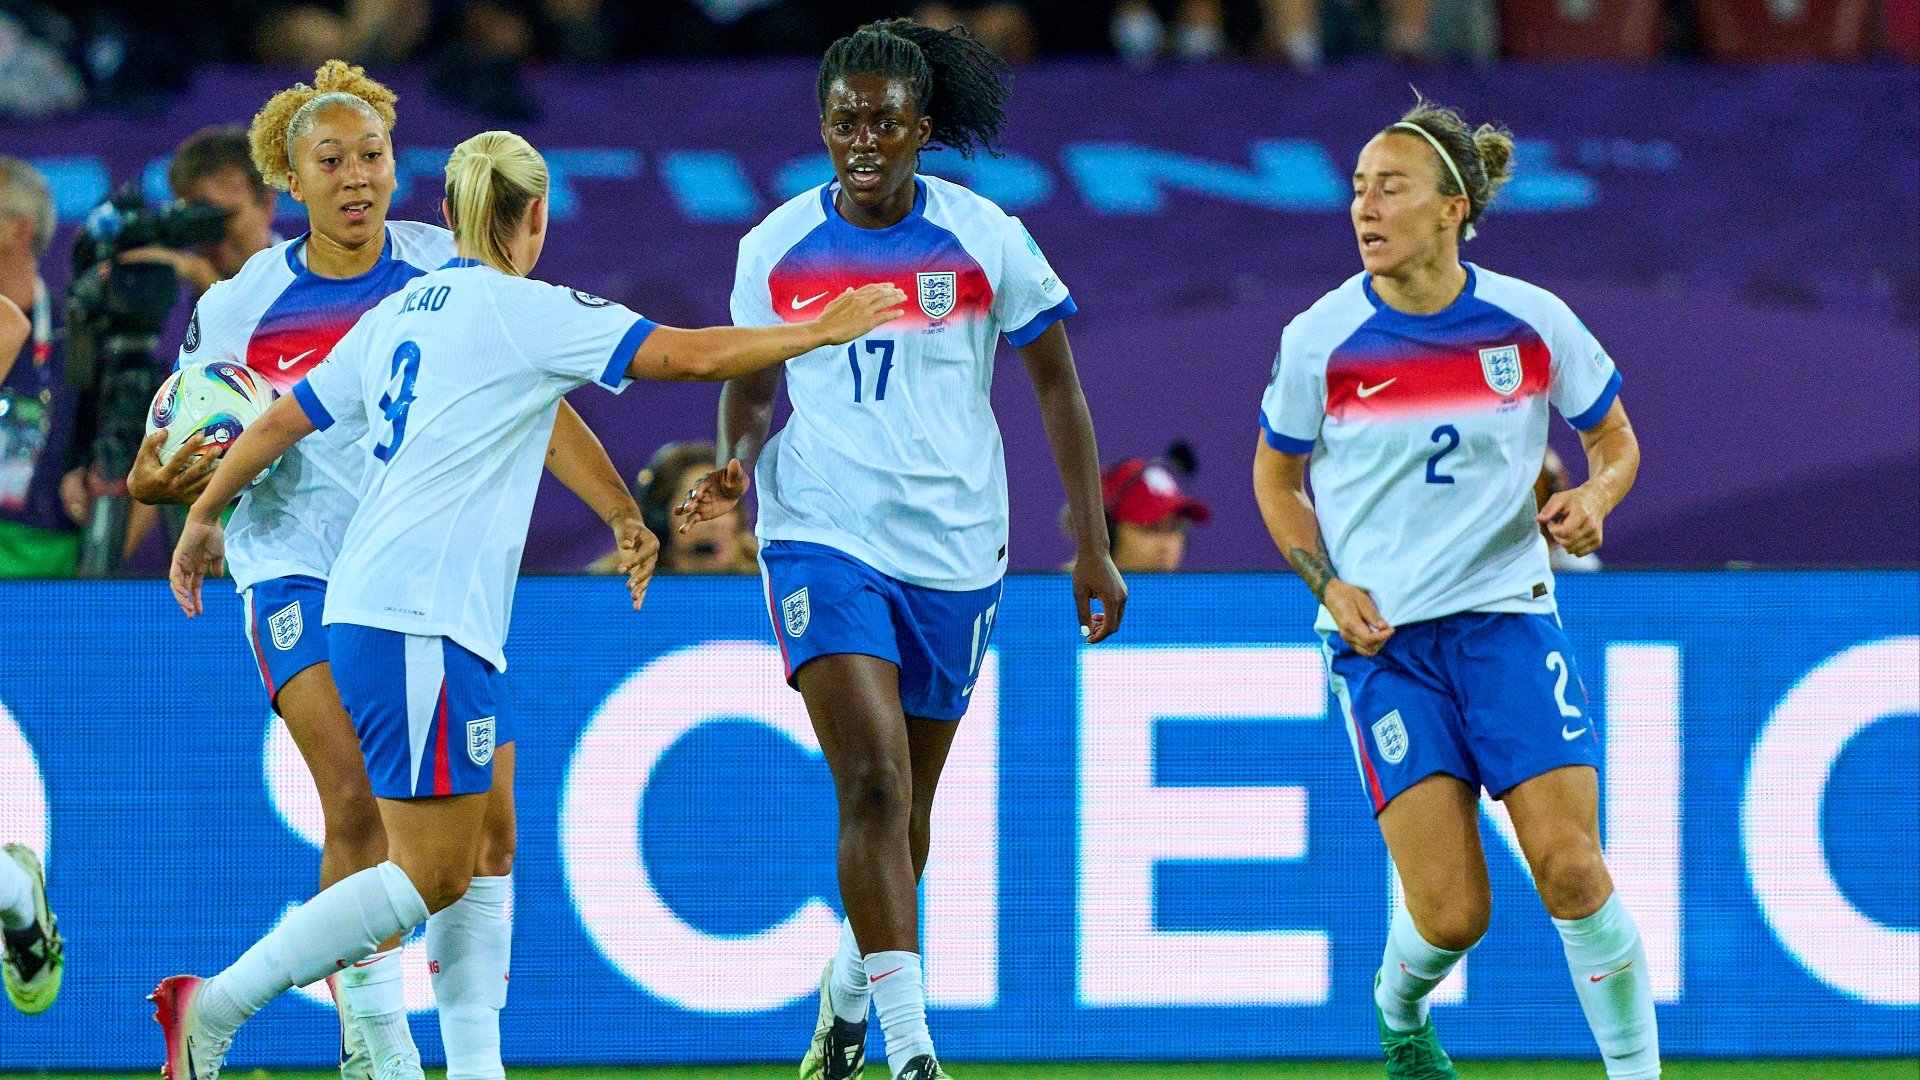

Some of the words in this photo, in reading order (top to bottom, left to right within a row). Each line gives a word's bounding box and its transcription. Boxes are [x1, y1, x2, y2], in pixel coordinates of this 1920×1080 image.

[373, 340, 421, 466] 9
[847, 339, 895, 403] 17
[1425, 424, 1460, 484] 2
[968, 601, 997, 677] 17
[1545, 650, 1582, 718] 2
